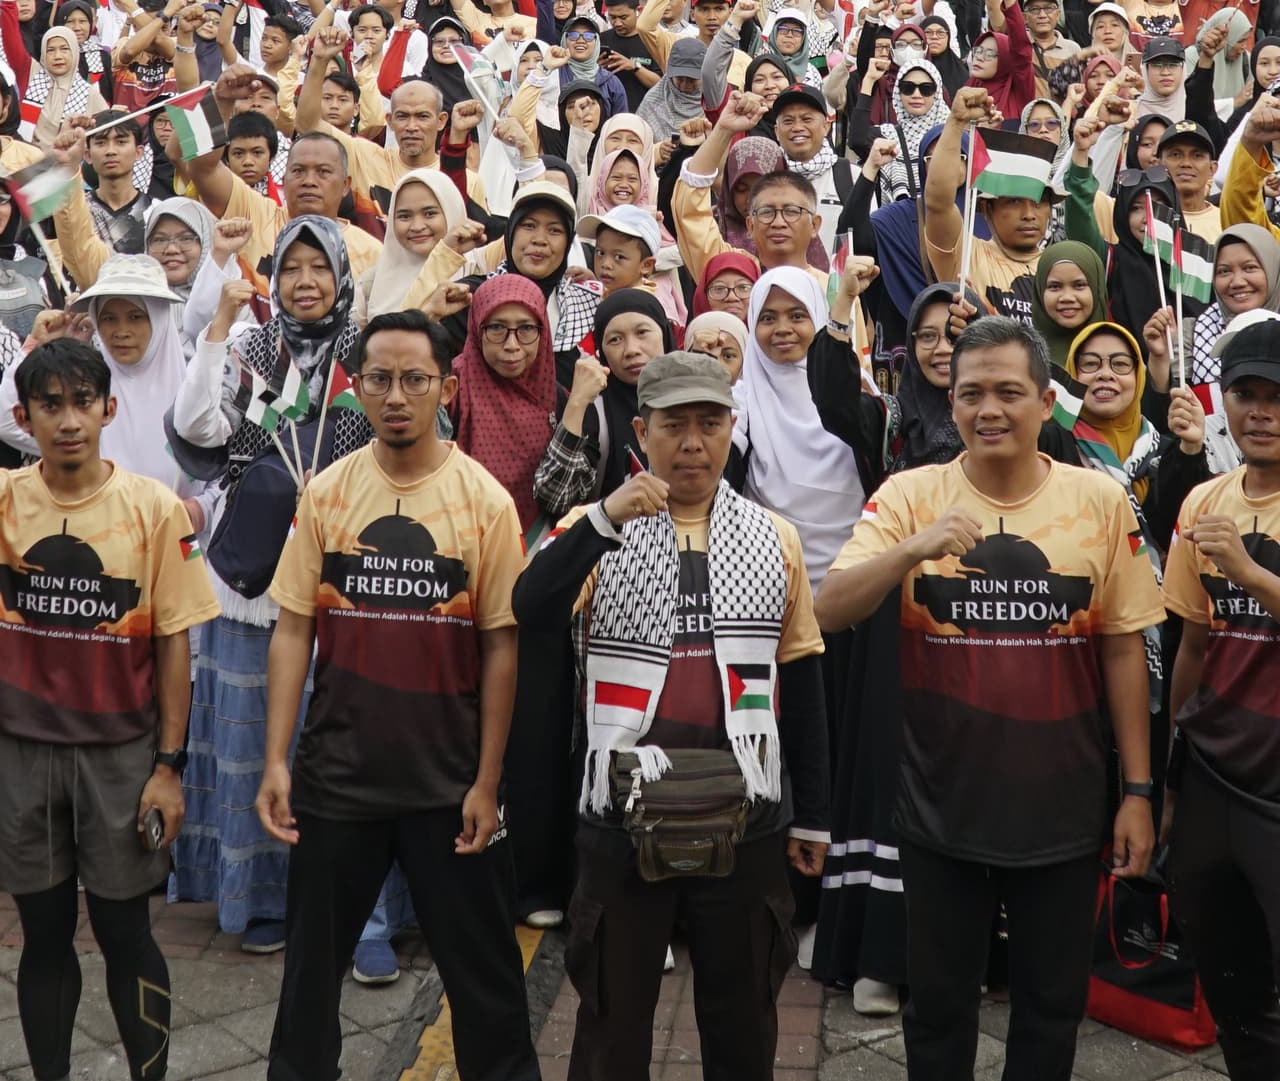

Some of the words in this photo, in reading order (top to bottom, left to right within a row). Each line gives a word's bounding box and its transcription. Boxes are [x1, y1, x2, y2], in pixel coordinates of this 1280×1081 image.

[363, 556, 397, 571] RUN
[403, 558, 436, 574] FOR
[30, 575, 64, 590] RUN
[69, 577, 102, 593] FOR
[345, 575, 449, 599] FREEDOM
[970, 580, 1008, 594] RUN
[1014, 580, 1050, 595] FOR
[17, 591, 118, 620] FREEDOM
[950, 601, 1068, 621] FREEDOM
[342, 609, 381, 620] Kebebasan
[382, 611, 408, 621] Adalah
[409, 613, 425, 623] Hak
[48, 629, 73, 639] Adalah
[75, 632, 90, 642] Hak
[91, 633, 115, 644] Segala
[949, 637, 994, 646] Kebebasan
[995, 637, 1025, 647] Adalah
[1026, 637, 1043, 646] Hak
